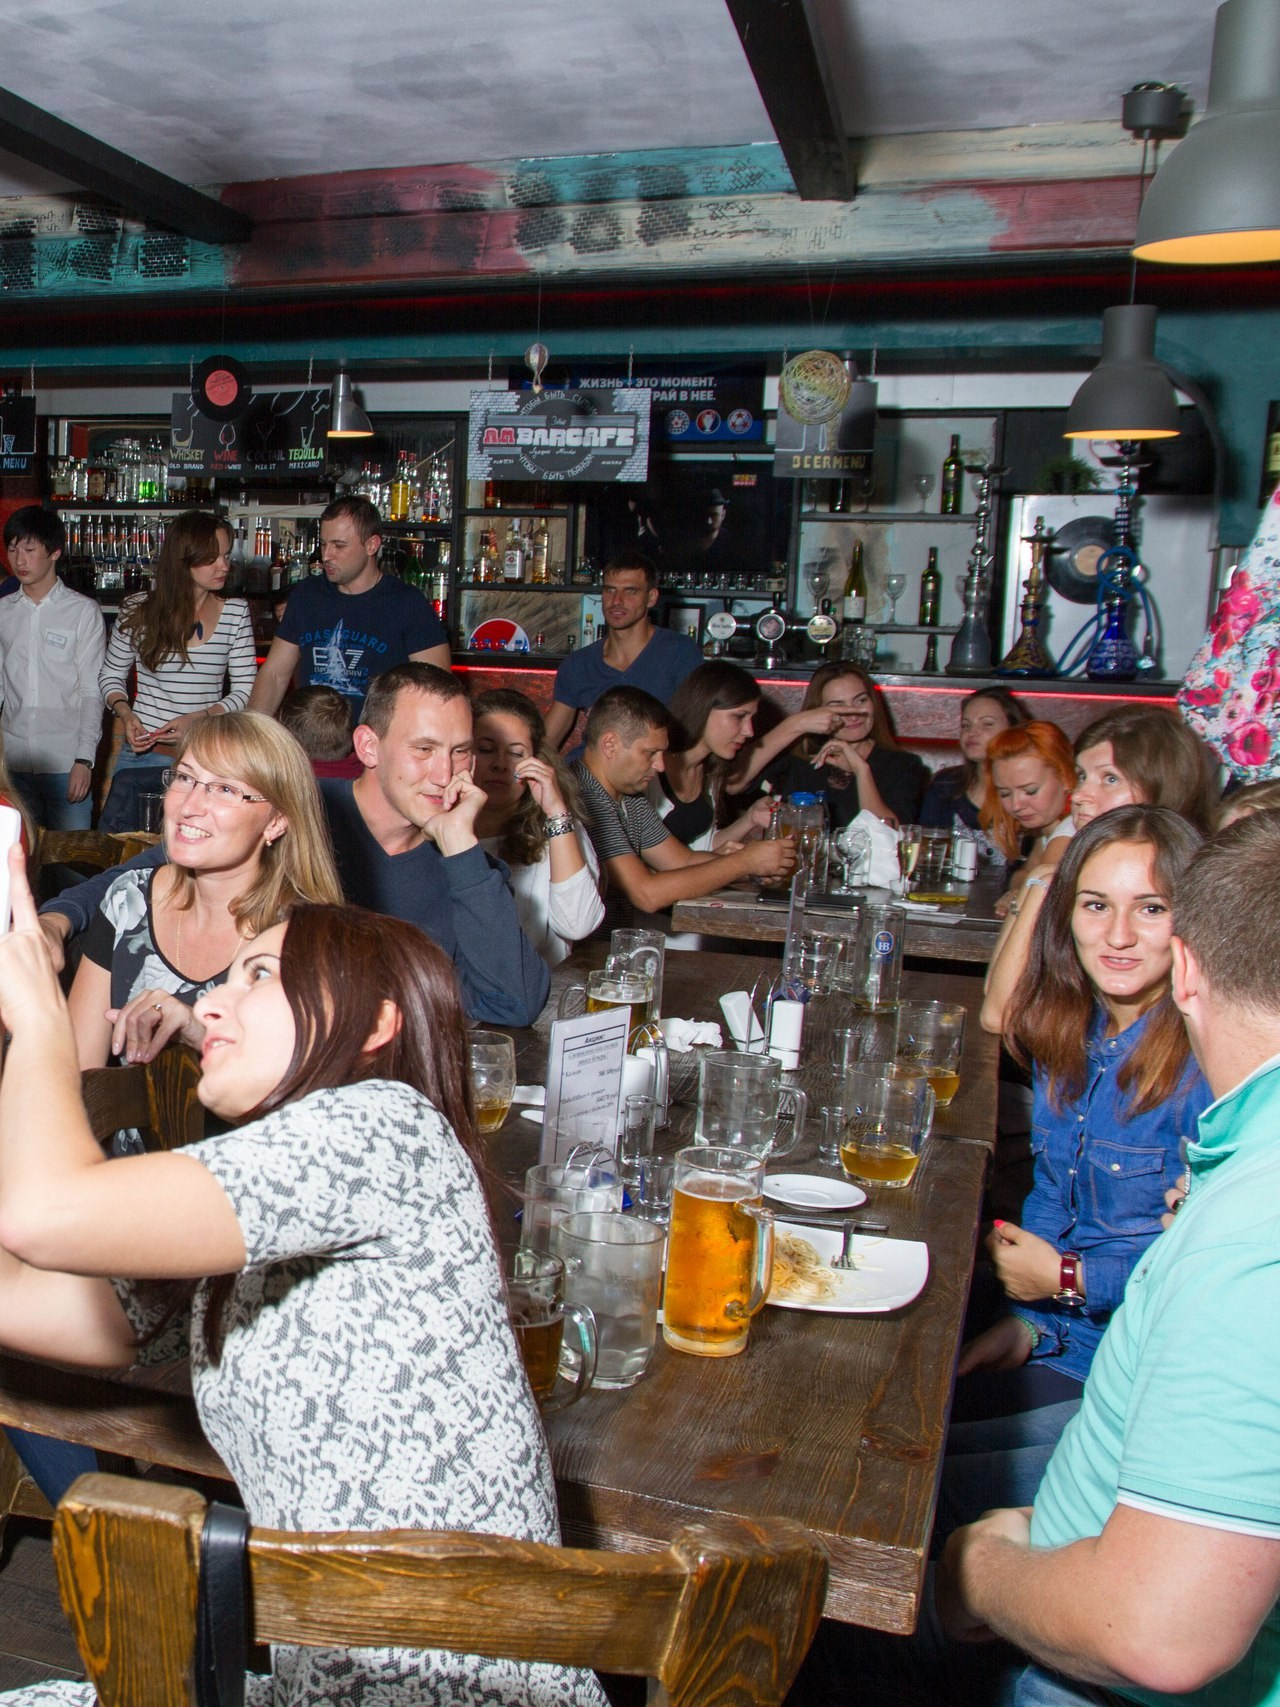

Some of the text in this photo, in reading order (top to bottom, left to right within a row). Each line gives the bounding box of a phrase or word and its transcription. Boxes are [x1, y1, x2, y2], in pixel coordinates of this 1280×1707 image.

[579, 376, 717, 389] ЖИЗНЬ ЭТО МОМЕНТ.
[680, 391, 688, 401] В
[691, 390, 716, 401] НЕЕ.
[520, 397, 542, 416] ЧТОБЫ
[544, 390, 566, 400] БЫТЬ
[171, 449, 206, 461] WHISKEY
[213, 450, 238, 462] WINE
[288, 447, 324, 461] TEQUILA
[3, 457, 27, 469] MENU
[542, 470, 565, 481] БЫТЬ
[299, 628, 389, 655] COAS GUARD
[313, 646, 365, 669] EA7
[878, 941, 890, 951] HB
